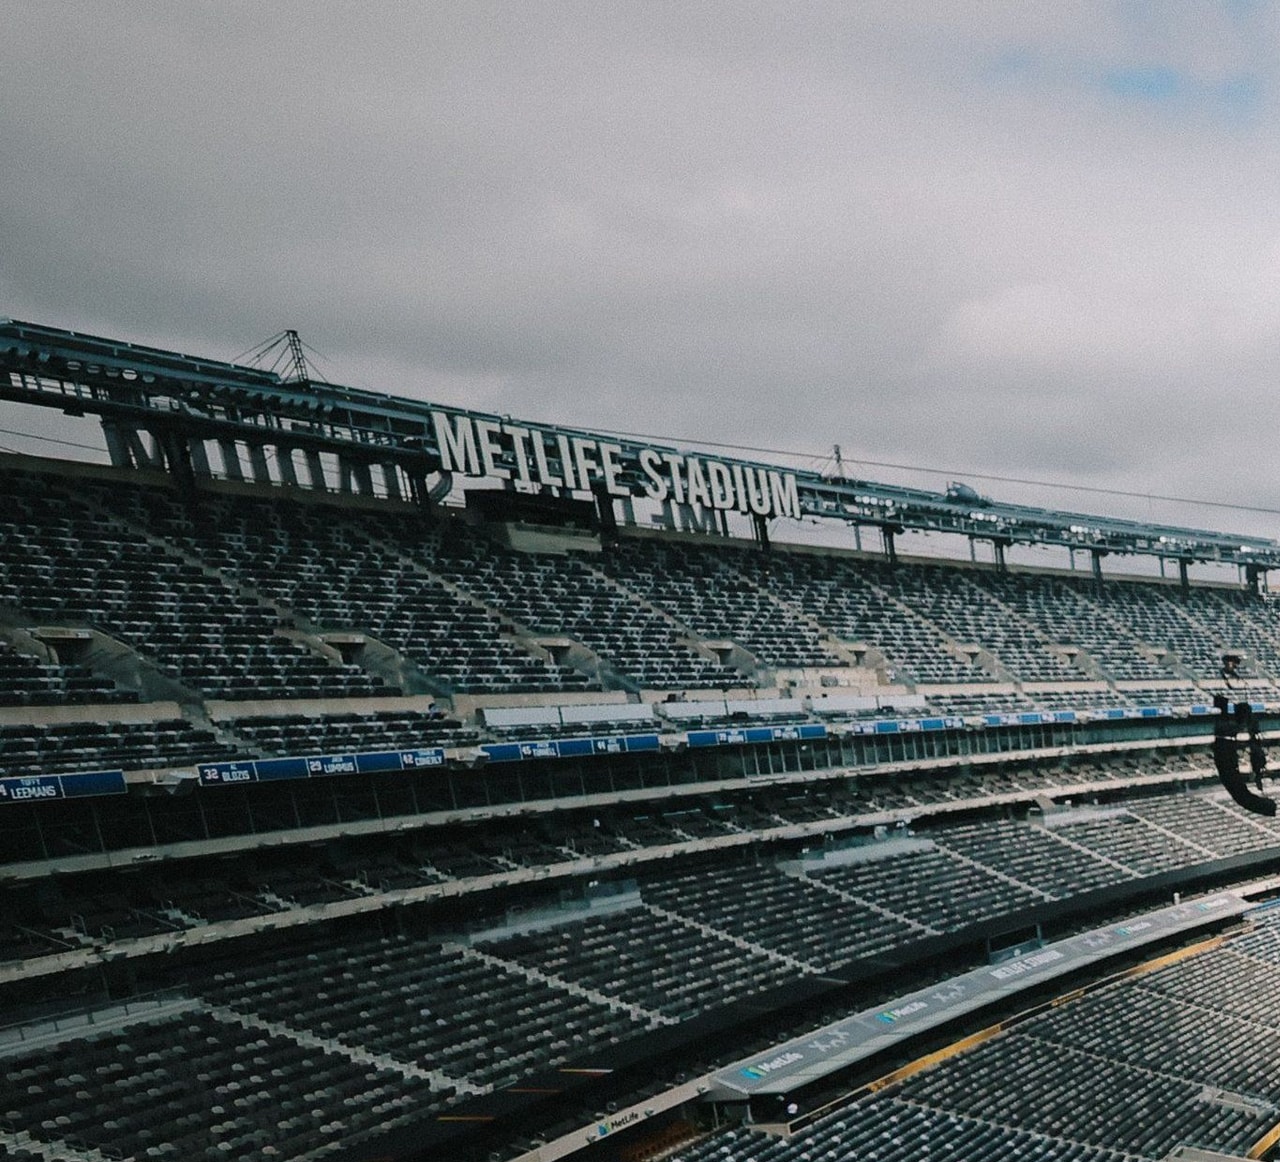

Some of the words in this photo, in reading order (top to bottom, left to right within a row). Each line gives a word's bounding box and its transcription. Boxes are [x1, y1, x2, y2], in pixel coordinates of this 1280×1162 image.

[430, 411, 630, 496] METLIFE
[638, 449, 801, 519] STADIUM
[203, 768, 219, 781] 32
[309, 761, 322, 772] 29
[10, 787, 57, 800] LEEMANS
[757, 1052, 803, 1072] MetLife
[611, 1111, 639, 1130] MetLife
